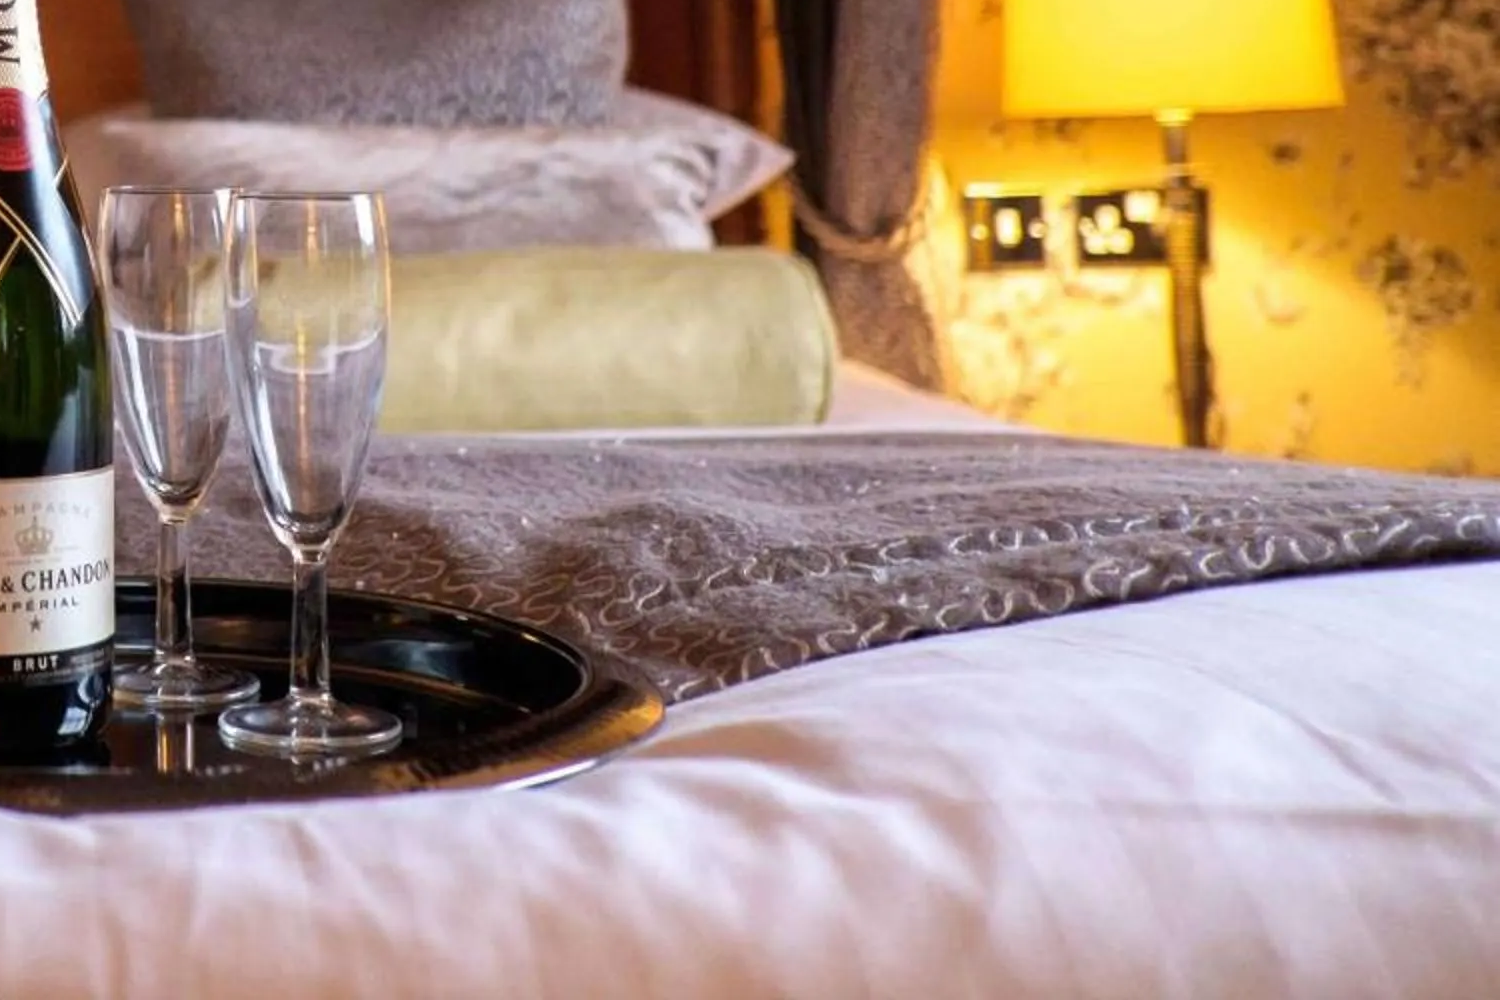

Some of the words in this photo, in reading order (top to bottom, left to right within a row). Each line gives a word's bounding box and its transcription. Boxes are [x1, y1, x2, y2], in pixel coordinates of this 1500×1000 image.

[1, 576, 14, 593] &
[21, 559, 110, 593] CHANDON
[12, 655, 59, 672] BRUT
